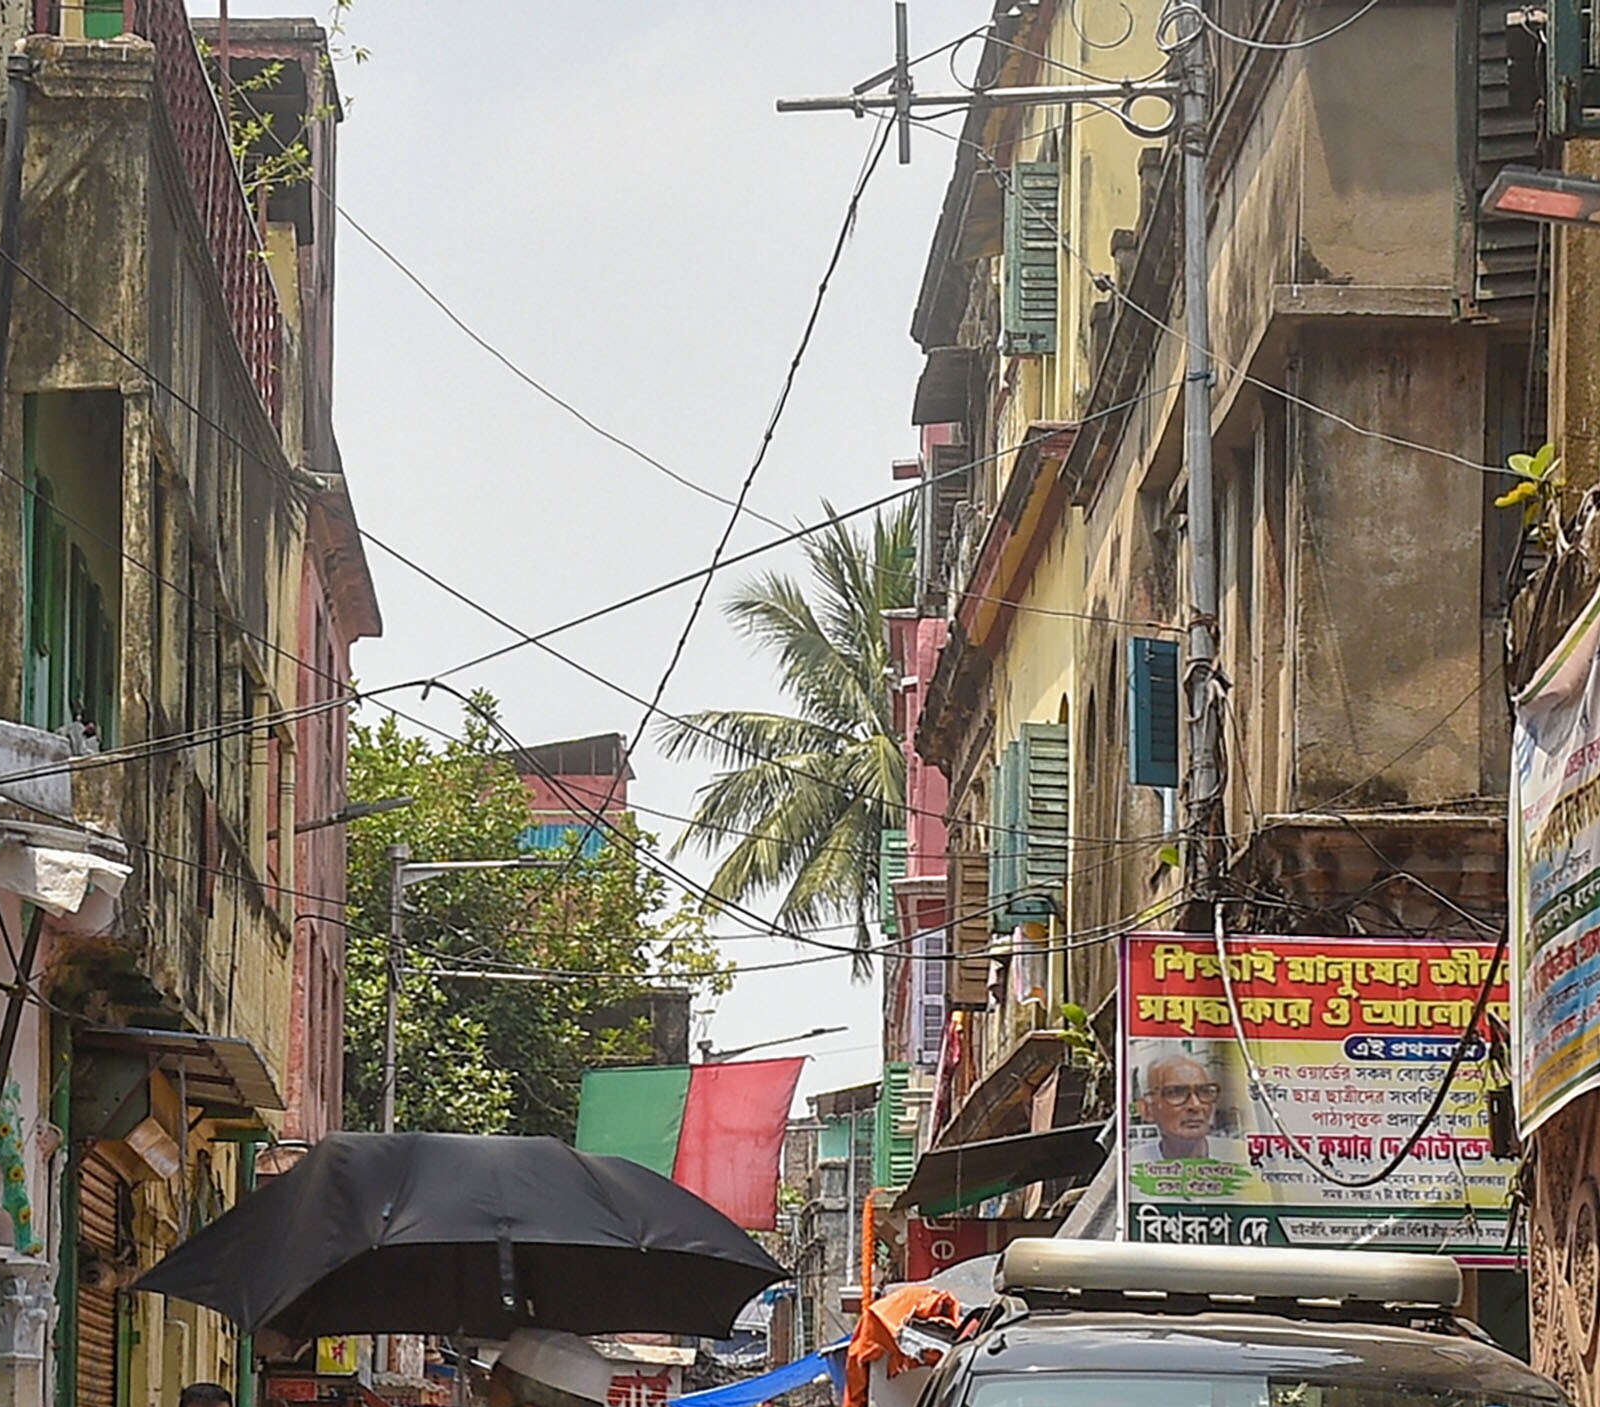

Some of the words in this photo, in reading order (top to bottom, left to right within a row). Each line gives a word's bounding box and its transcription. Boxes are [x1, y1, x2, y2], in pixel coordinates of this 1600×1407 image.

[1284, 955, 1420, 998] মানুষের
[1136, 995, 1231, 1034] সমৃদ্ধ
[1239, 998, 1312, 1028] করে
[1322, 998, 1350, 1026] ও
[1360, 998, 1474, 1027] আলো
[1352, 1038, 1385, 1058] এই
[1272, 1065, 1290, 1079] নং
[1355, 1066, 1392, 1080] সকল
[1292, 1089, 1320, 1103] ছাত্র
[1325, 1085, 1384, 1104] ছাত্রীদের
[1317, 1134, 1372, 1167] কুমার
[1381, 1137, 1403, 1159] দে
[1136, 1204, 1232, 1244] বিশ্বরূপ
[1240, 1217, 1270, 1245] দে
